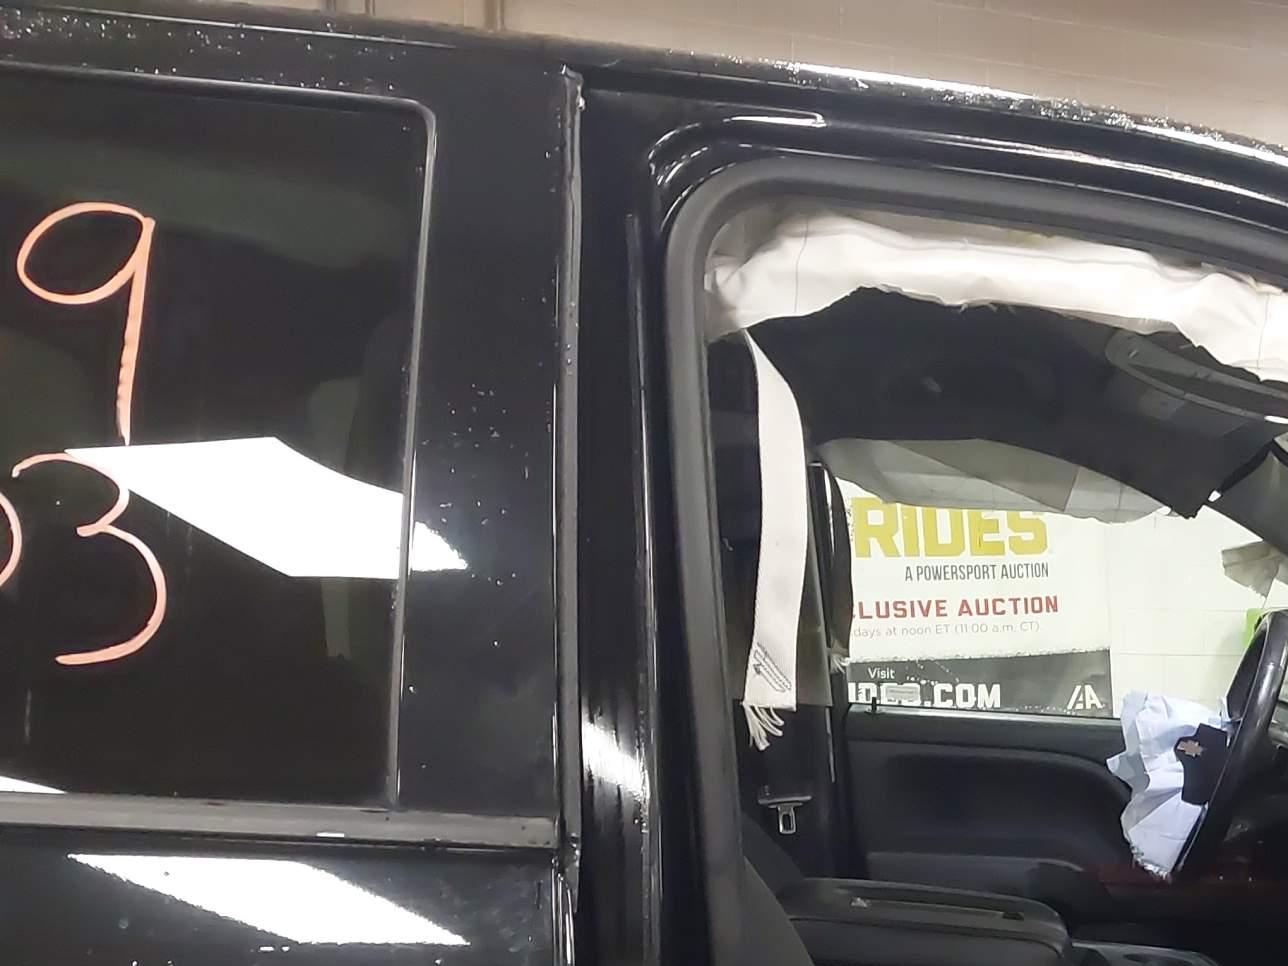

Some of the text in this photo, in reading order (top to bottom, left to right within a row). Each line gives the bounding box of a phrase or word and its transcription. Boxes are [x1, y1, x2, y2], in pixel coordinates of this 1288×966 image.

[17, 202, 155, 446] 9
[853, 497, 1049, 558] RIDES
[0, 453, 167, 665] 3
[905, 562, 1049, 582] A POWERSPORT AUCTION
[852, 595, 1059, 620] LUSIVE AUCTION
[851, 624, 882, 639] days
[885, 625, 897, 636] at
[901, 624, 932, 636] noon
[935, 623, 950, 635] ET
[868, 667, 895, 679] Visit
